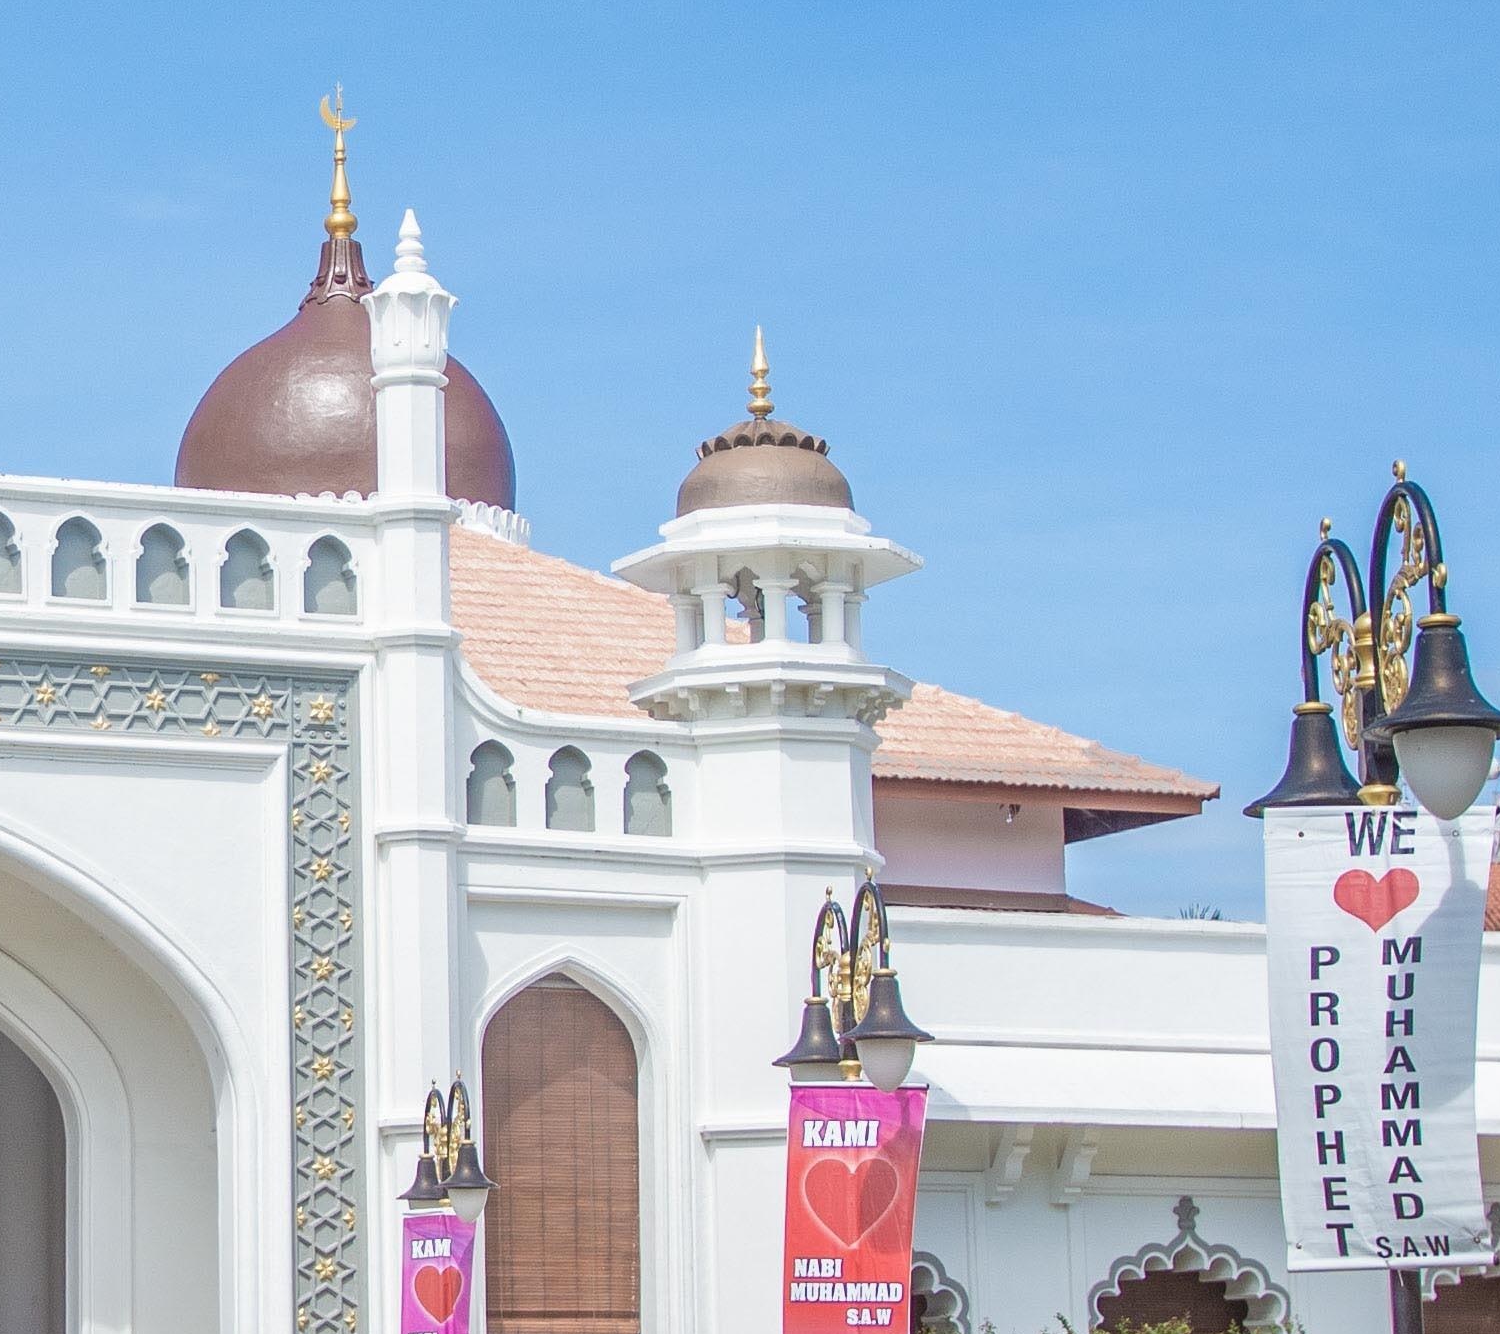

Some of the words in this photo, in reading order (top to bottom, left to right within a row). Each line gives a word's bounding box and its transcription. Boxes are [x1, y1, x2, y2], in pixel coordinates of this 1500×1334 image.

[1345, 810, 1418, 857] WE
[1381, 936, 1425, 1221] MUHAMMAD
[1309, 945, 1354, 1258] PROPHET
[803, 1120, 880, 1148] KAMI
[1375, 1235, 1450, 1259] S.A.W
[793, 1258, 843, 1278] NABI
[790, 1282, 904, 1303] MUHAMMAD
[846, 1308, 893, 1326] S.A.W
